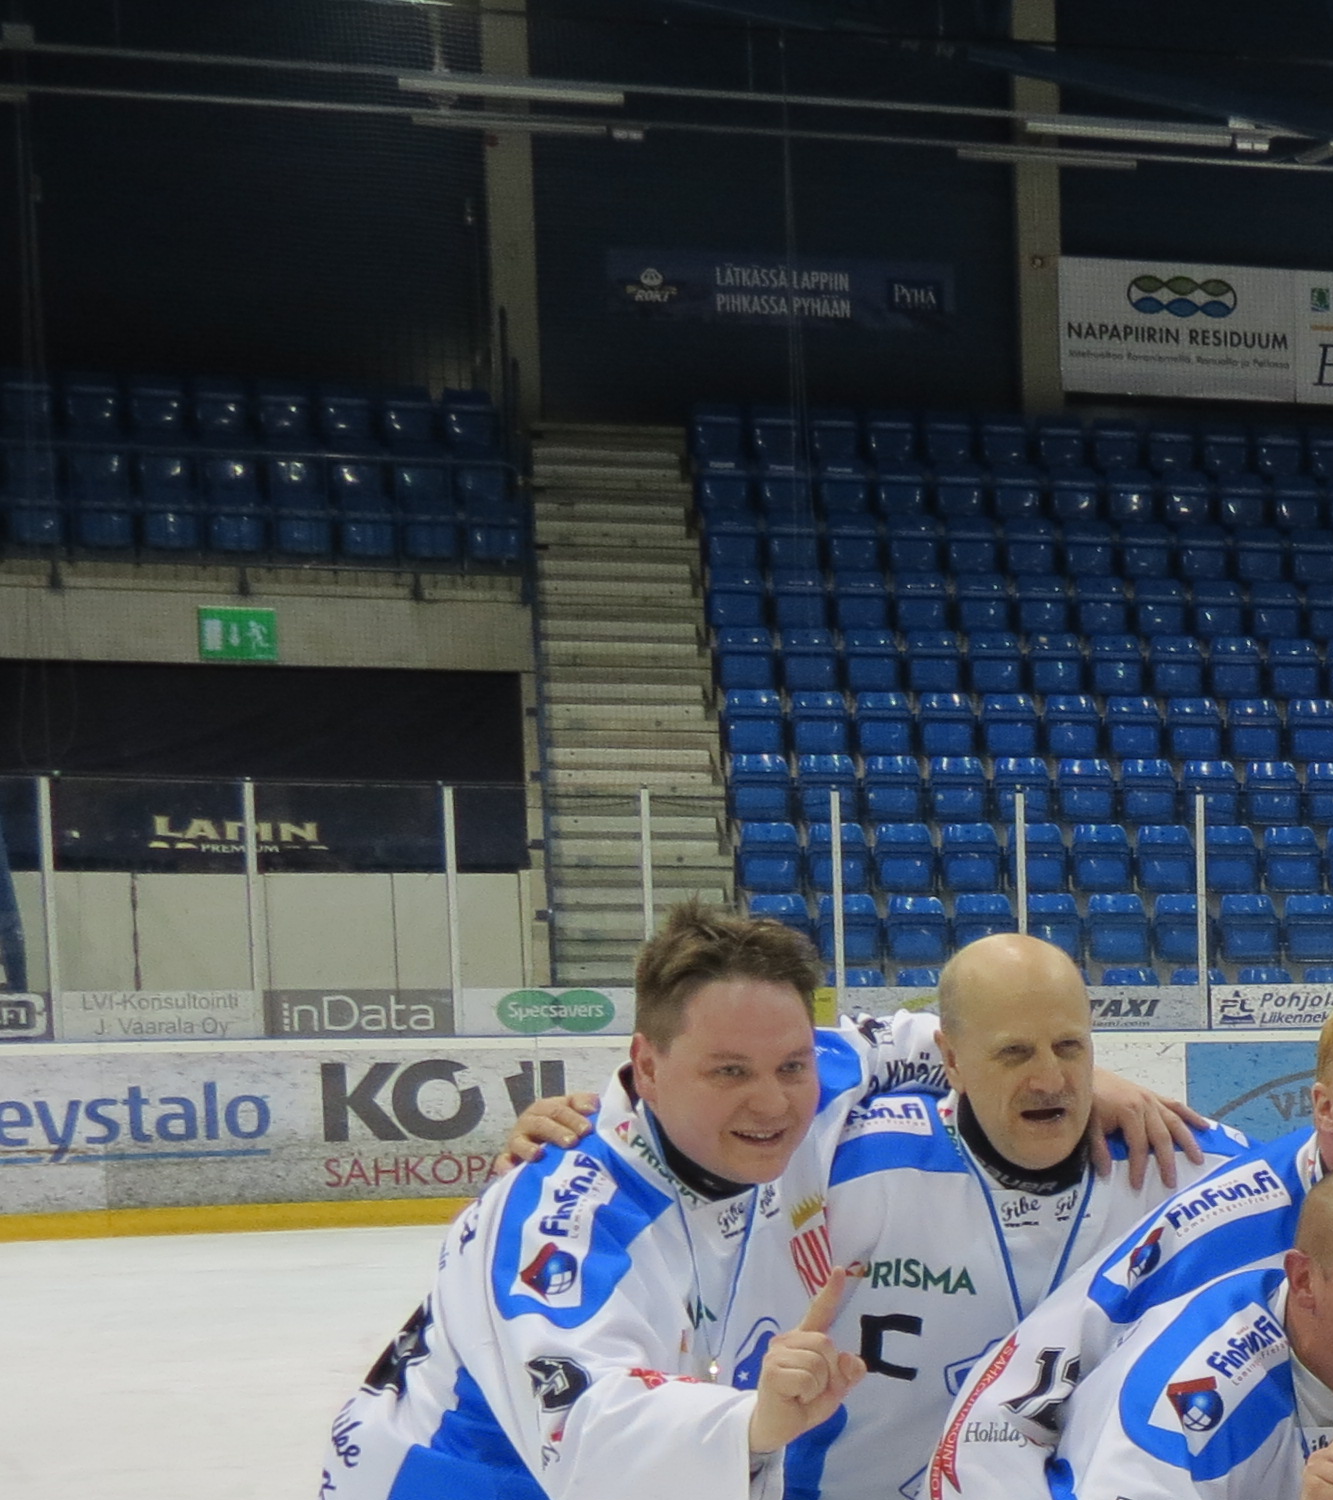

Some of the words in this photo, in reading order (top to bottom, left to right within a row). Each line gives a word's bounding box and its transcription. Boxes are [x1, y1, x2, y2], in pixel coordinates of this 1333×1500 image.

[715, 263, 788, 290] LÄTKÄSSÄ
[792, 269, 850, 293] LAPPIIN
[792, 294, 851, 319] PYHÄÄN
[1067, 321, 1181, 346] NAPAPIIRIN
[1189, 328, 1289, 352] RESIDUUM
[200, 843, 281, 853] PREMUM
[282, 994, 437, 1034] inData
[507, 1002, 604, 1022] Specsavers
[861, 1313, 923, 1381] C
